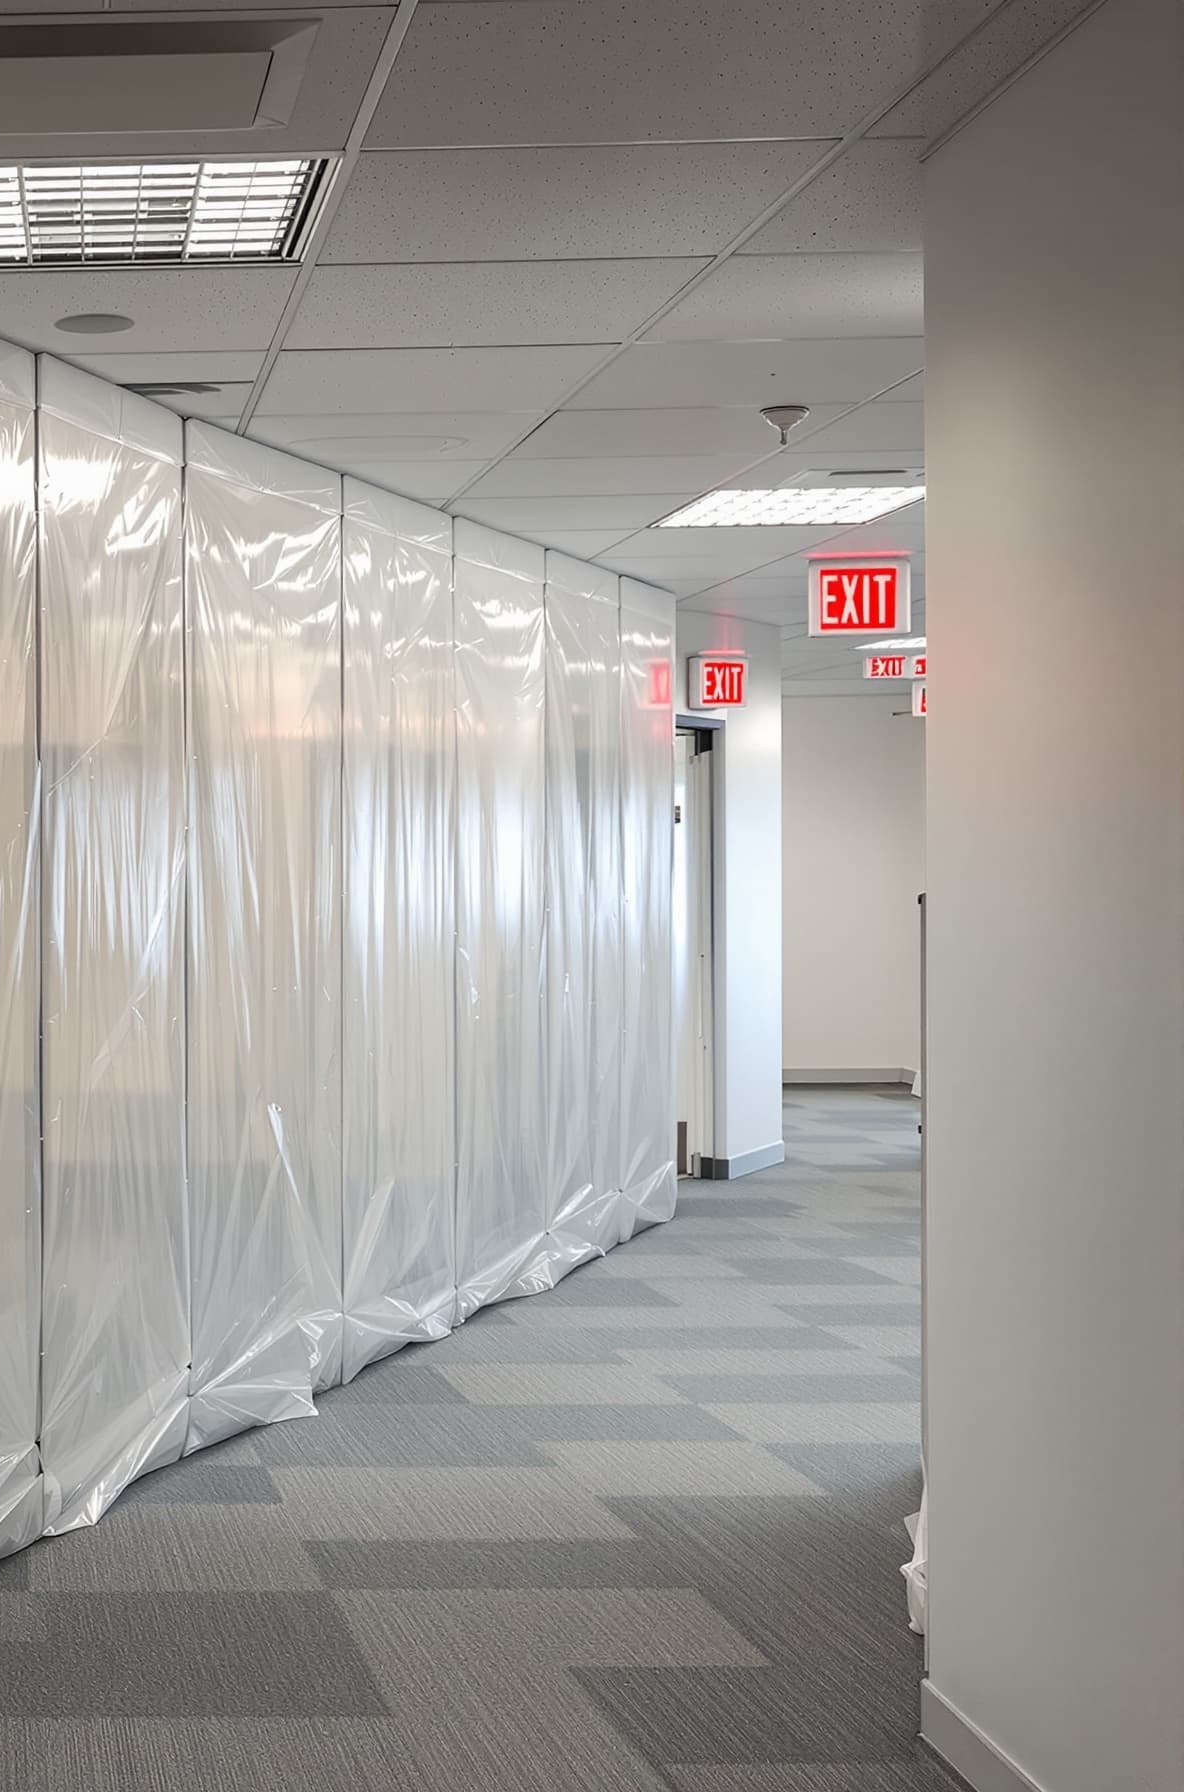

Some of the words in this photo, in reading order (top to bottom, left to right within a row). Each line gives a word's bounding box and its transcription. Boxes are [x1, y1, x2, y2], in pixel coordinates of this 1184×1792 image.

[821, 574, 892, 624] EXIT
[703, 666, 741, 700] EXIT
[870, 657, 905, 676] EXIT
